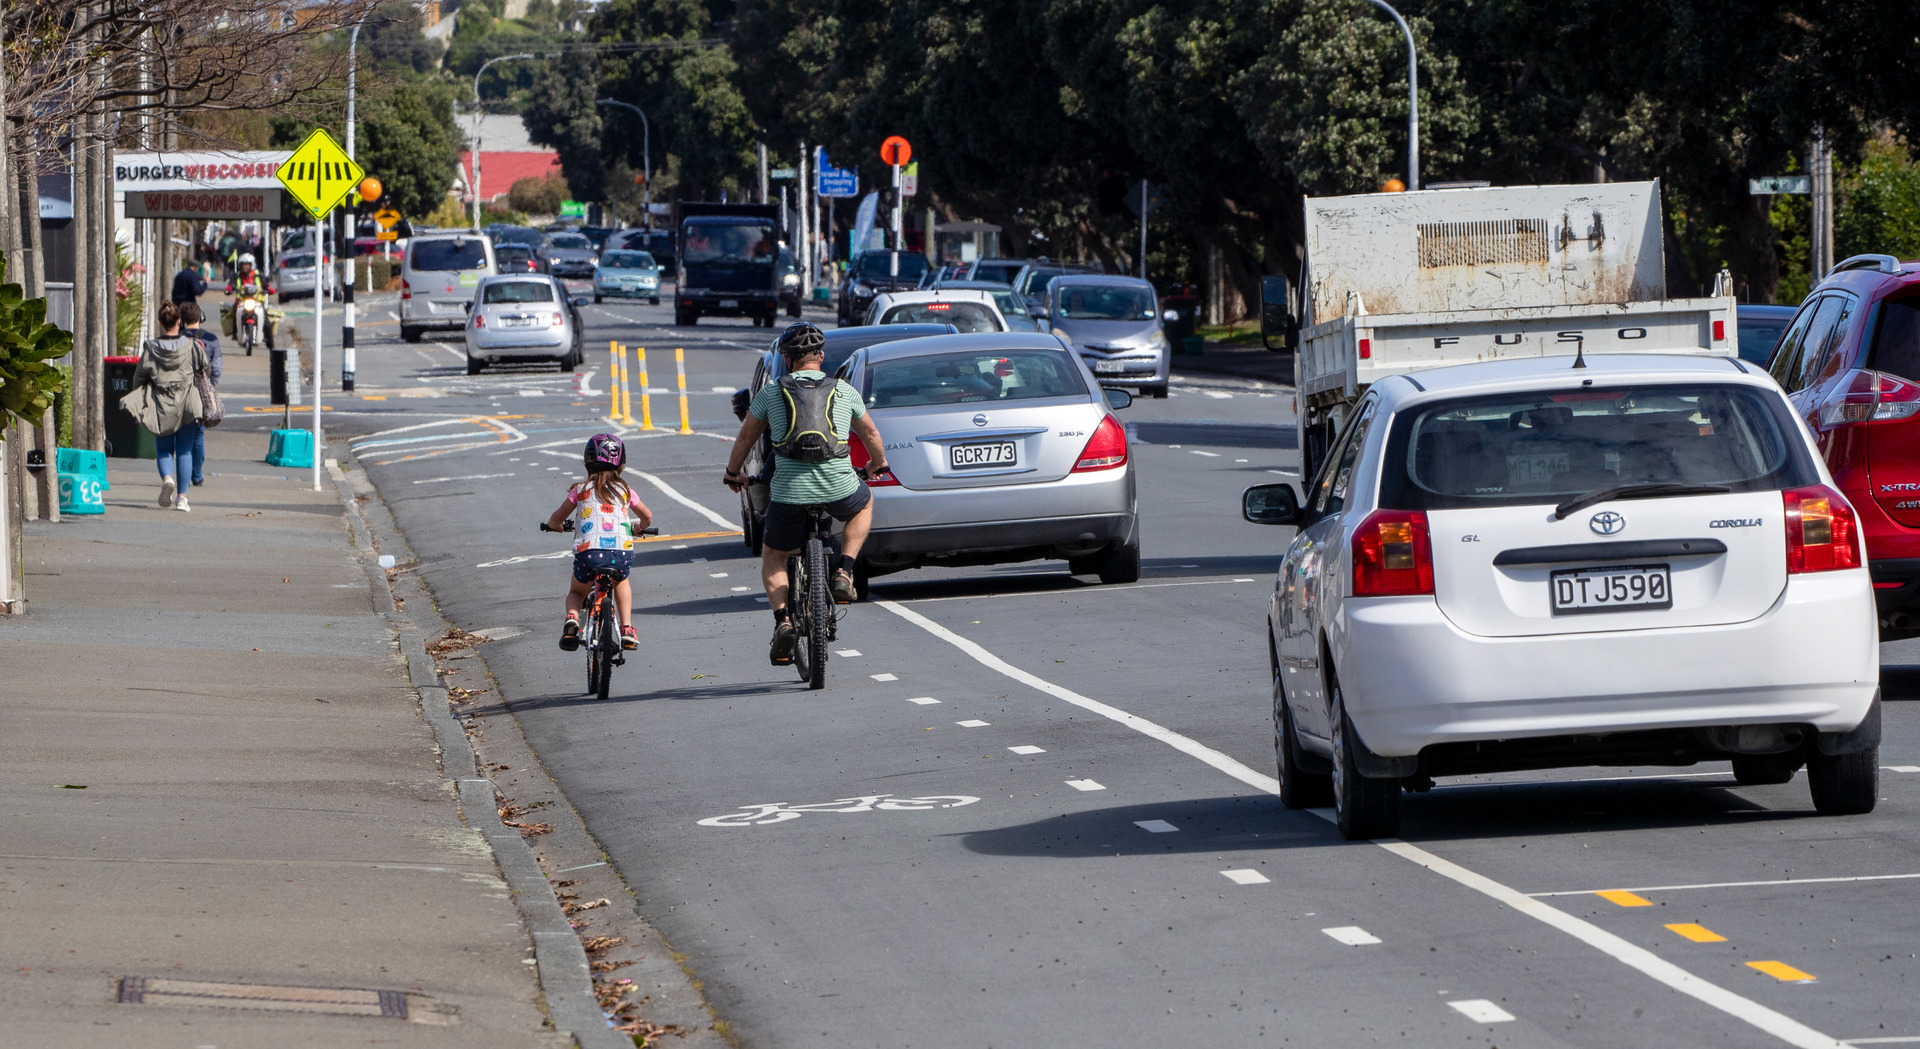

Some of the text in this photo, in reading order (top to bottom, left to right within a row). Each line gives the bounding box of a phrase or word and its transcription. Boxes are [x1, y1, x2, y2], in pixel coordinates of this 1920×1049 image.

[144, 194, 264, 213] WISCONSIN
[1434, 328, 1647, 348] FUSO
[882, 442, 914, 451] EANA
[954, 445, 1014, 464] GCR773
[1895, 501, 1920, 509] 4W
[1709, 518, 1763, 529] COROLLA
[1461, 534, 1481, 543] GL
[1557, 573, 1665, 605] DTJ590
